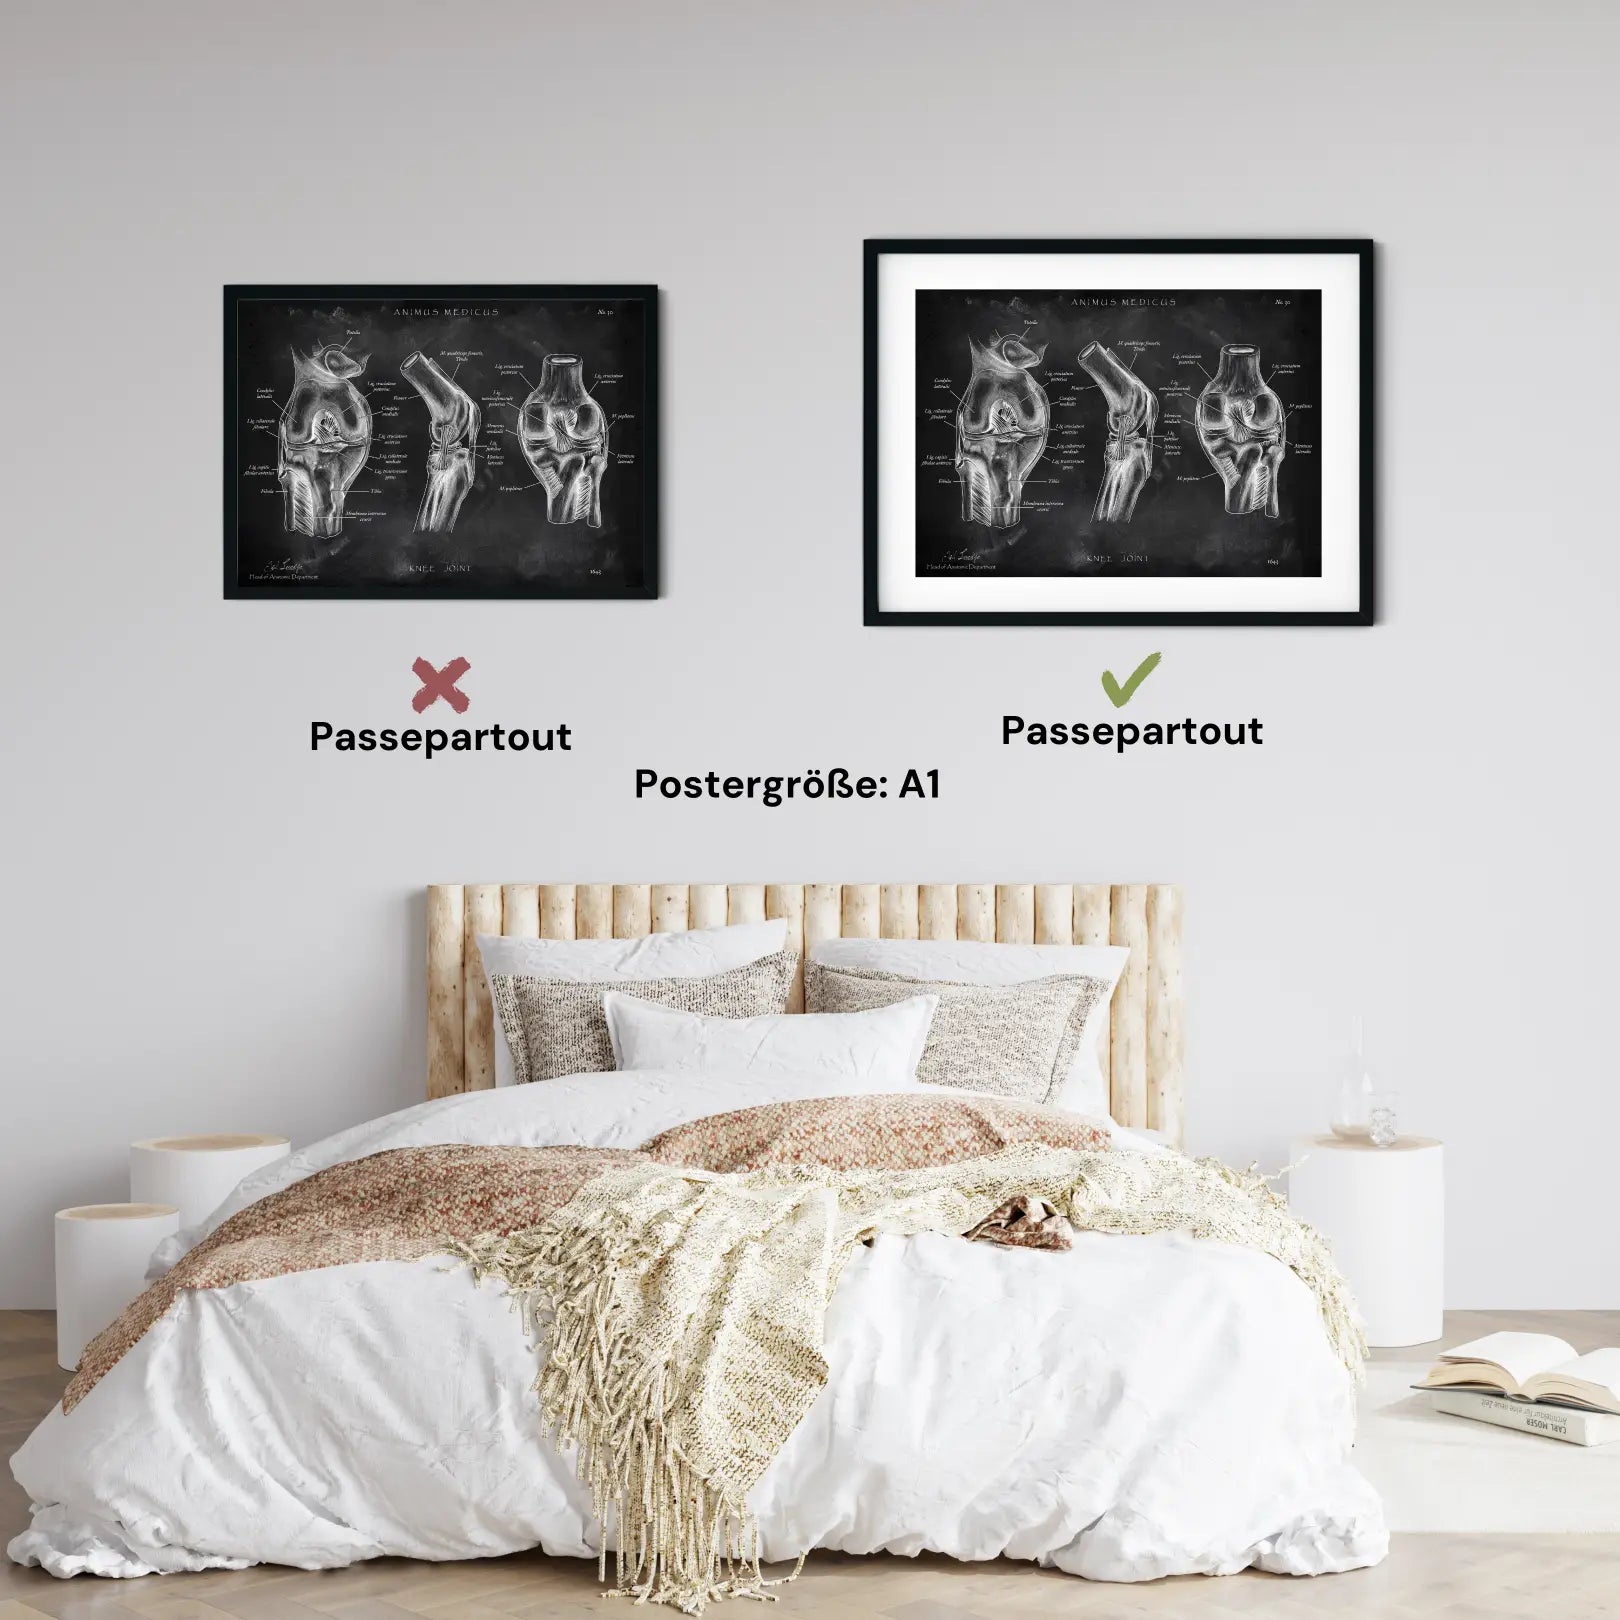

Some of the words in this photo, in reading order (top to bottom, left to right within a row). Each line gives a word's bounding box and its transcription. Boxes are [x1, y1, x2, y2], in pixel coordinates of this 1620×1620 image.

[1071, 298, 1116, 306] ANIMUS
[1122, 298, 1176, 306] MEDICUS
[393, 308, 439, 316] ANIMUS
[445, 308, 499, 316] MEDICUS
[1087, 555, 1112, 563] KNEE
[1121, 555, 1149, 563] JOINT
[409, 565, 435, 573] KNEE
[443, 565, 471, 573] JOINT
[1526, 1417, 1548, 1430] MOSER
[1550, 1423, 1567, 1435] CARL
